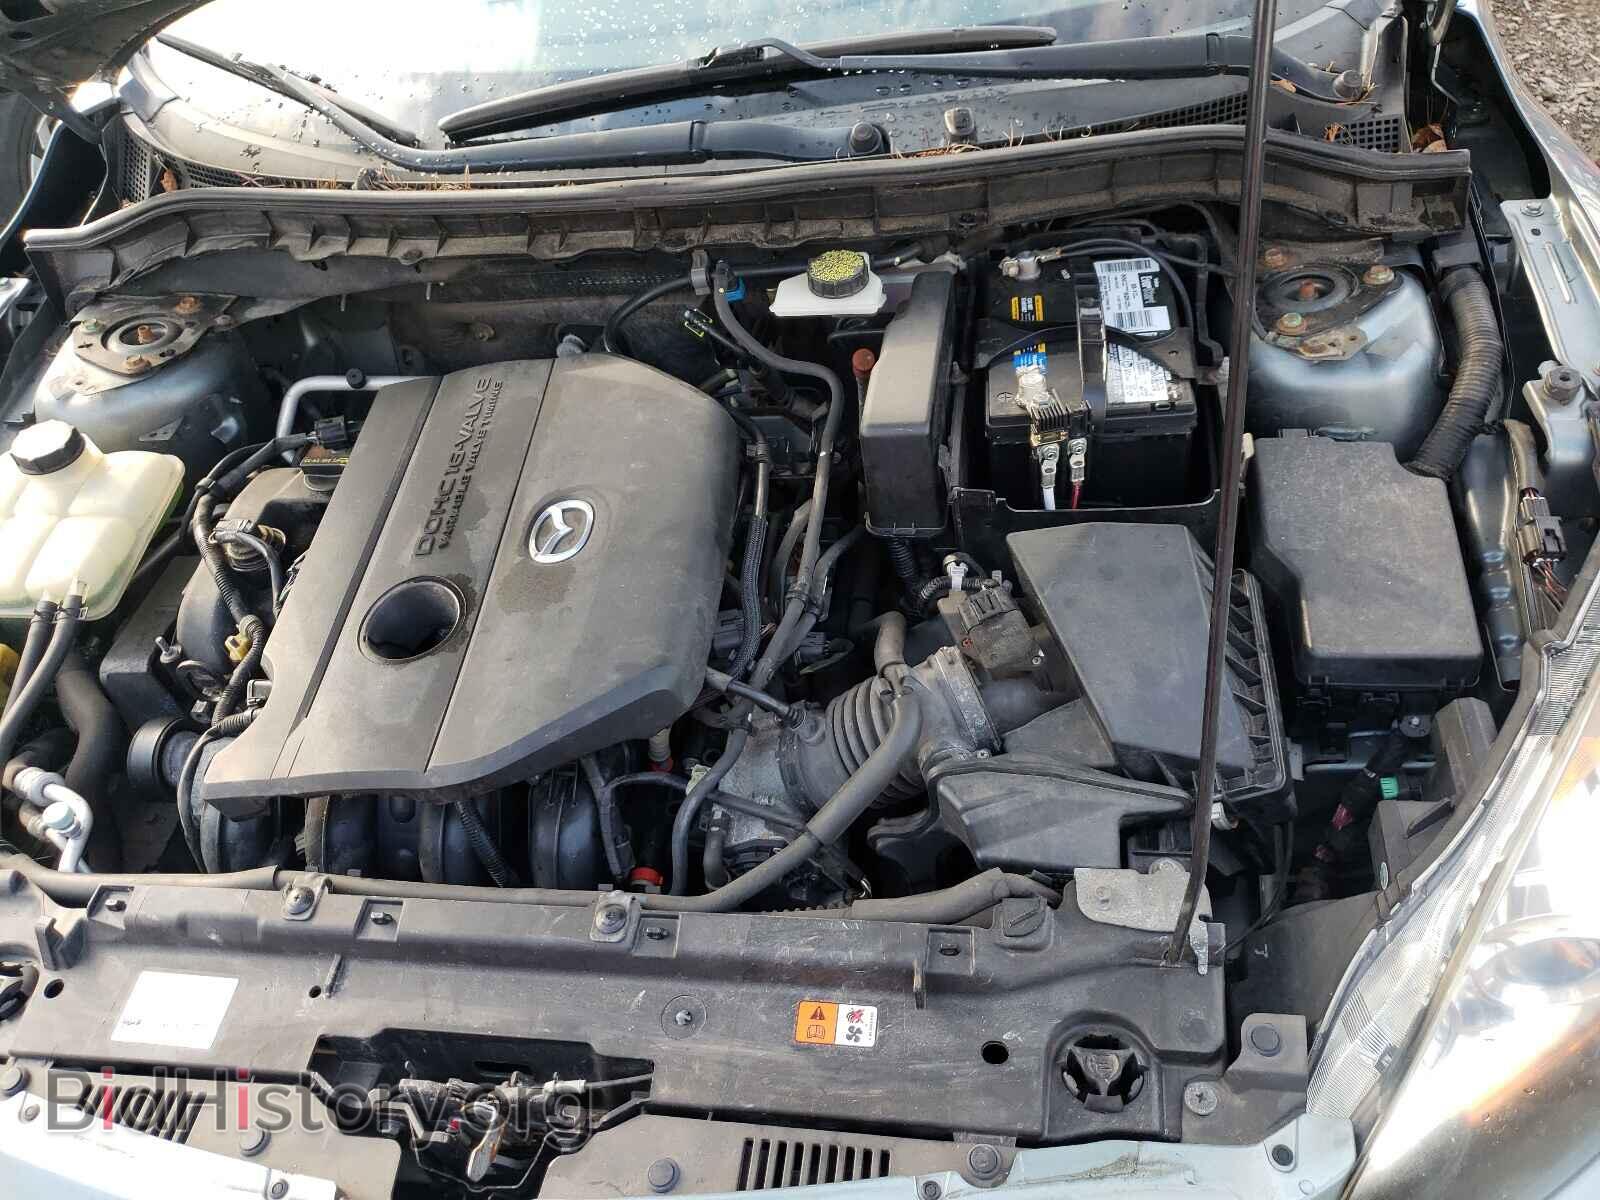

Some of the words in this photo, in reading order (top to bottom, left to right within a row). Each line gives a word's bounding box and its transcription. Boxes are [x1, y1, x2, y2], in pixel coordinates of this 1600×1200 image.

[415, 476, 456, 556] DOHC
[438, 474, 472, 549] VARIABLE
[467, 429, 488, 473] VALVE
